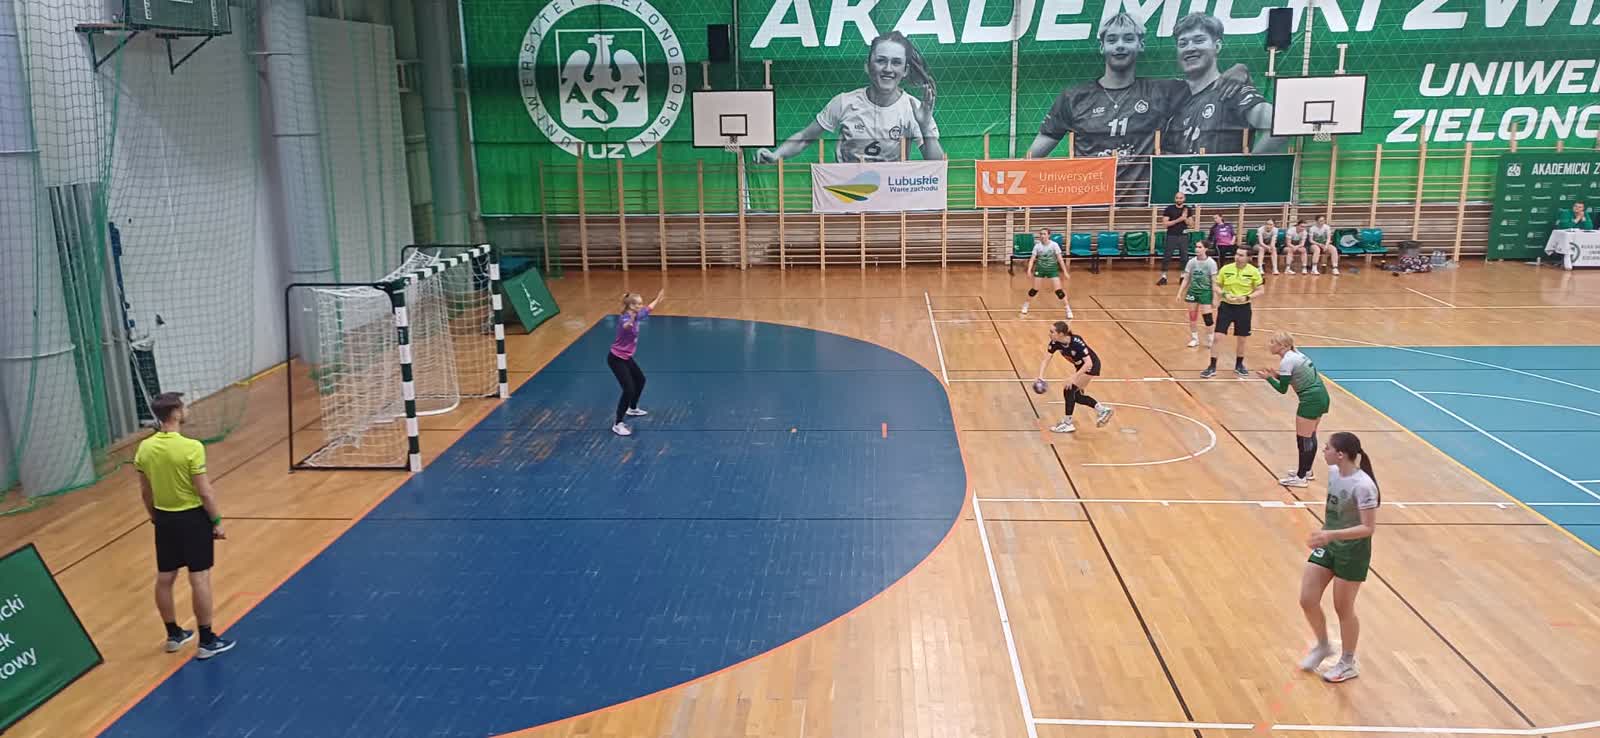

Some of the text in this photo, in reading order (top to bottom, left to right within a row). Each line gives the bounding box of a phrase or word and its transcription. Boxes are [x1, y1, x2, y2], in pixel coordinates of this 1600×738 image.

[1107, 117, 1128, 137] 11
[588, 144, 626, 158] UZ
[864, 140, 881, 156] 6
[1217, 163, 1266, 172] Akademicki
[1531, 162, 1591, 175] AKADEMICKI
[888, 176, 939, 186] Lubuskie
[1039, 171, 1104, 182] Uniwersytet
[1039, 182, 1110, 194] Zielonogórski
[1215, 185, 1257, 194] Sportowy
